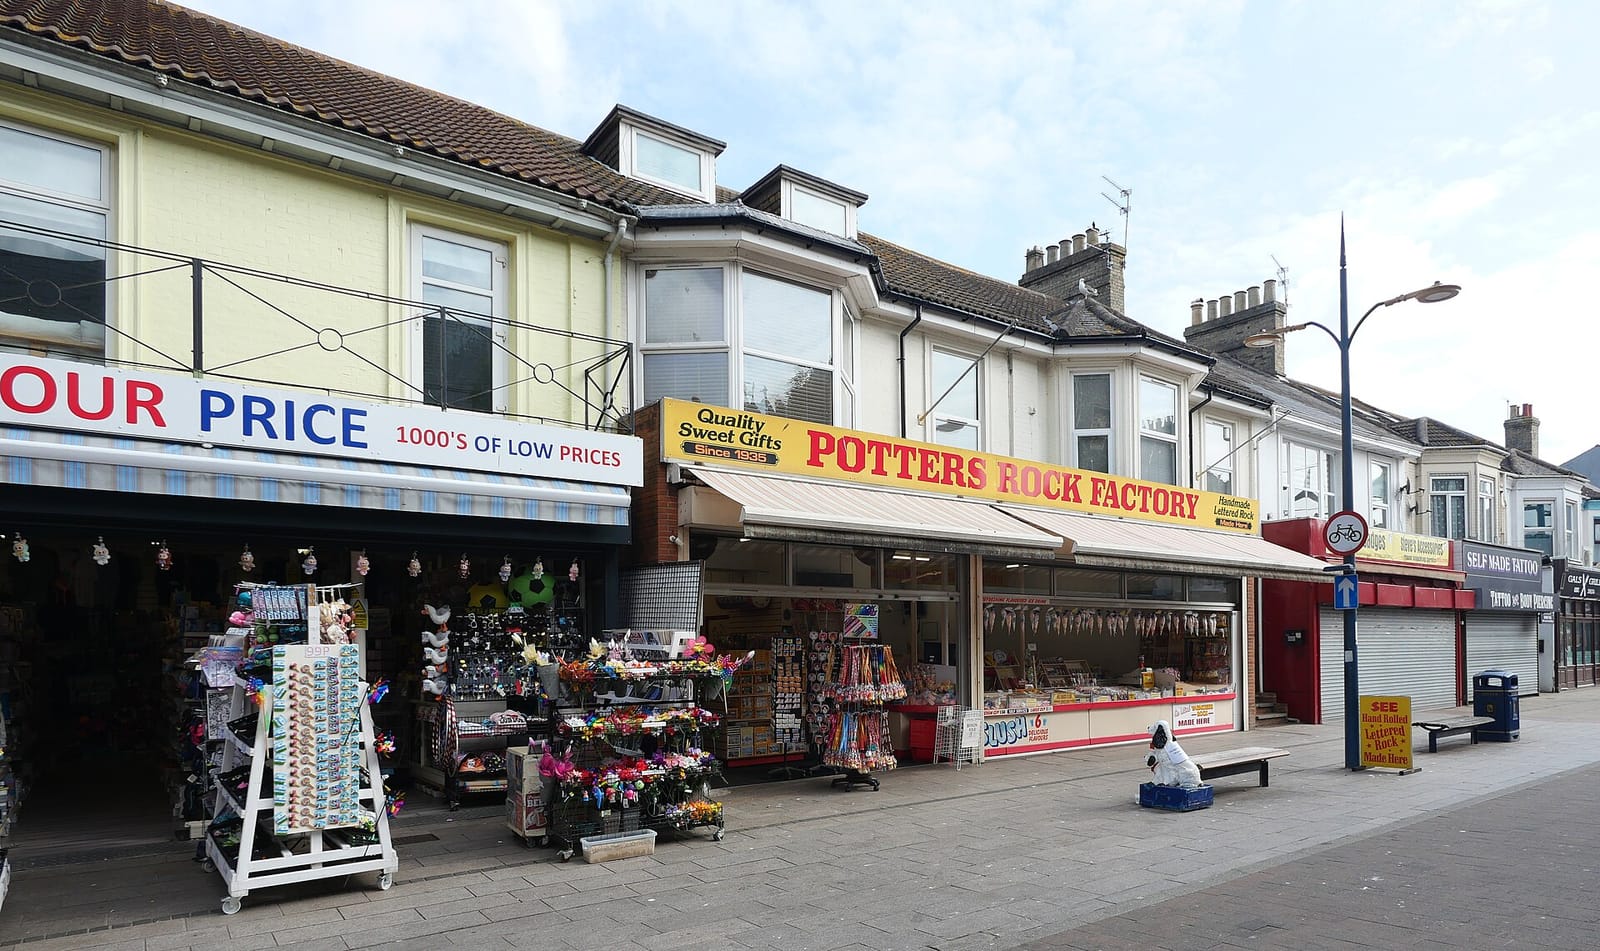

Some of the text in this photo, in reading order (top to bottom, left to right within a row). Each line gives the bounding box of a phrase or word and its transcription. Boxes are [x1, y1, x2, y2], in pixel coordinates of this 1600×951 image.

[0, 364, 369, 450] OUR PRICE
[697, 408, 766, 433] Quality
[396, 424, 622, 468] 1000'S OF LOW PRICES
[678, 422, 782, 451] Sweet Gifts
[694, 443, 767, 464] Since 1935
[806, 429, 1200, 520] POTTERS ROCK FACTORY
[1218, 495, 1251, 510] Handmade
[1213, 505, 1254, 520] Lettered Rock
[1364, 531, 1386, 551] adges
[1467, 551, 1488, 569] SELF
[1488, 554, 1511, 571] MADE
[1511, 557, 1539, 575] TATTOO
[1490, 590, 1512, 608] TATTOO
[1371, 701, 1398, 713] SEE
[1035, 714, 1042, 728] 6
[1362, 713, 1408, 724] Hand Rolled
[984, 715, 1028, 747] SLUSH
[1365, 725, 1406, 740] Lettered
[1375, 735, 1399, 751] Rock
[1363, 751, 1409, 765] Made Here
